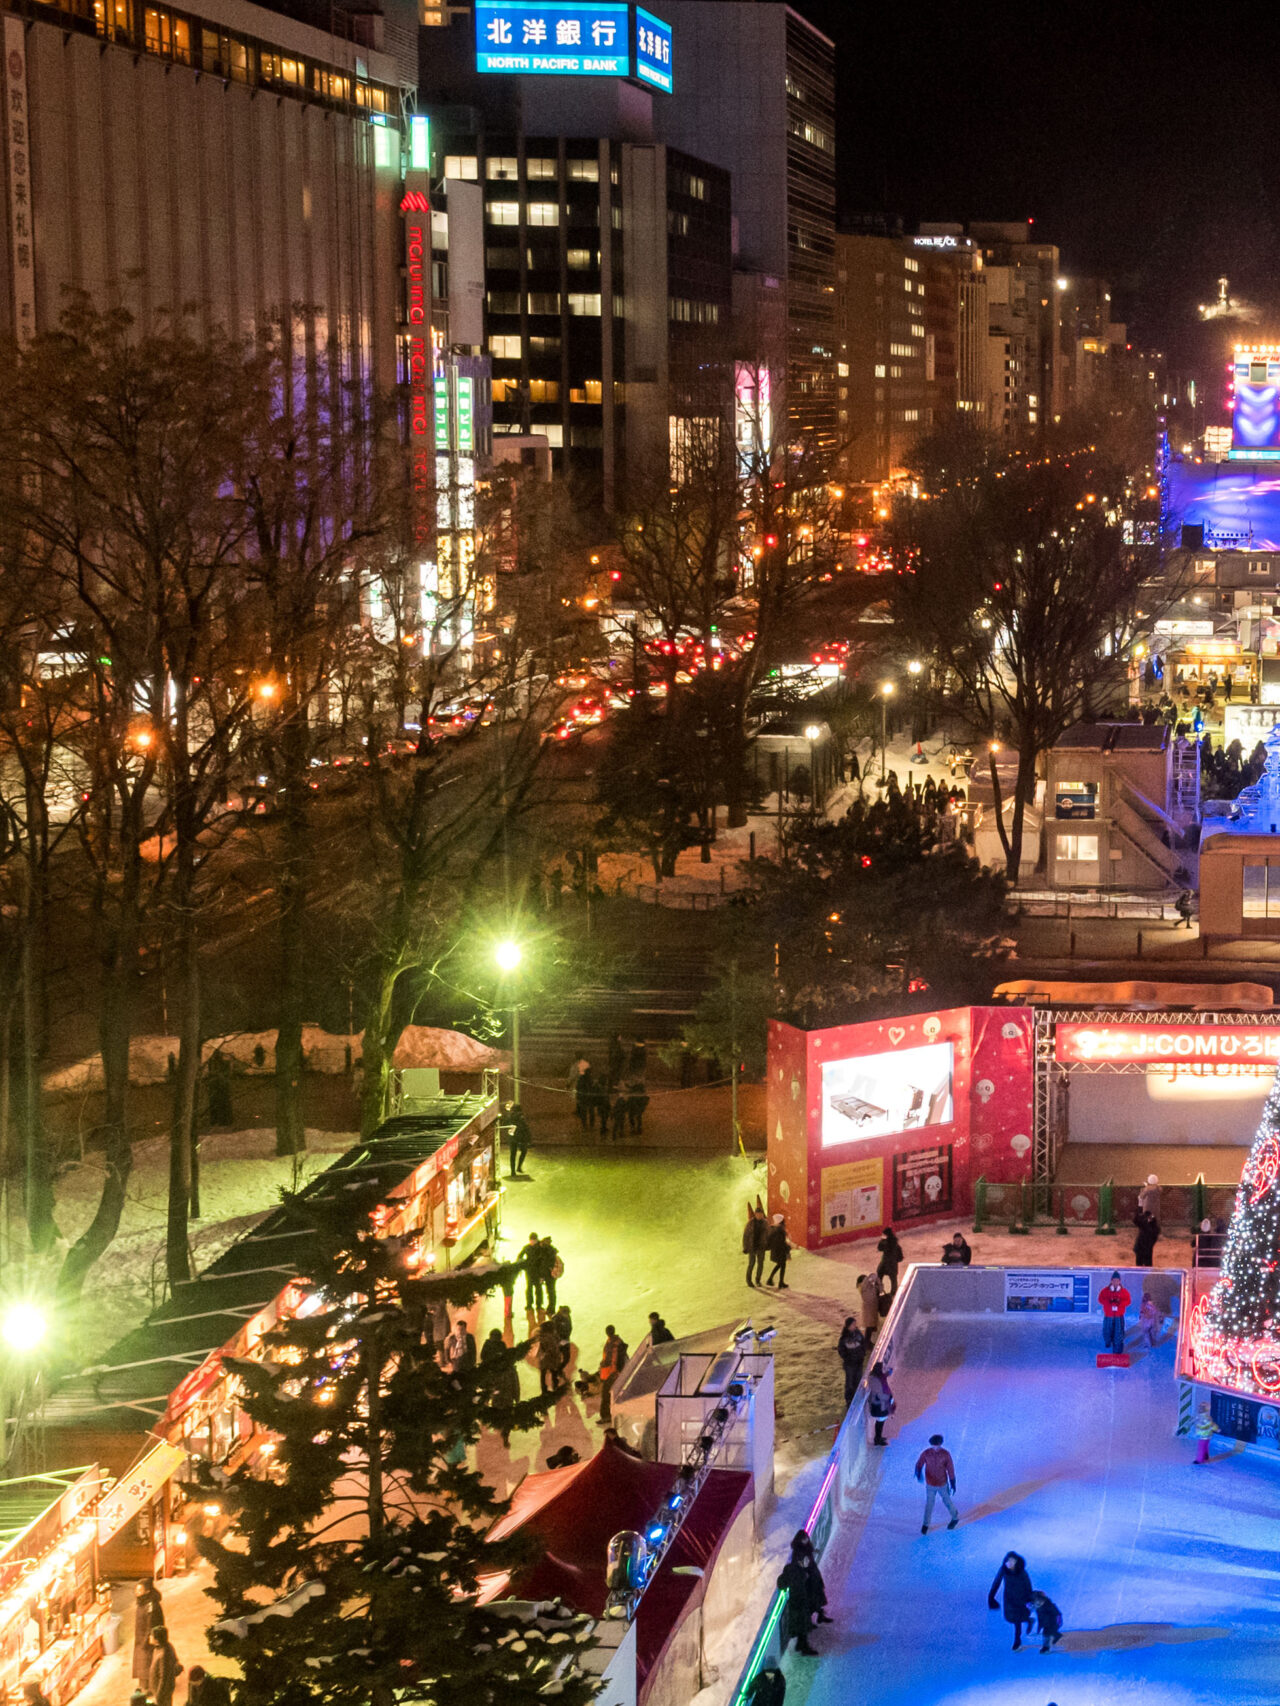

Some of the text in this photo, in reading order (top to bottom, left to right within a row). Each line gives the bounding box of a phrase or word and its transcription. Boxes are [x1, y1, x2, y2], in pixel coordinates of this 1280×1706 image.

[486, 18, 617, 46] 北洋銀行
[638, 26, 669, 64] 北洋銀行
[487, 57, 618, 71] NORTH PACIFIC BANK
[914, 238, 933, 246] HOTEL
